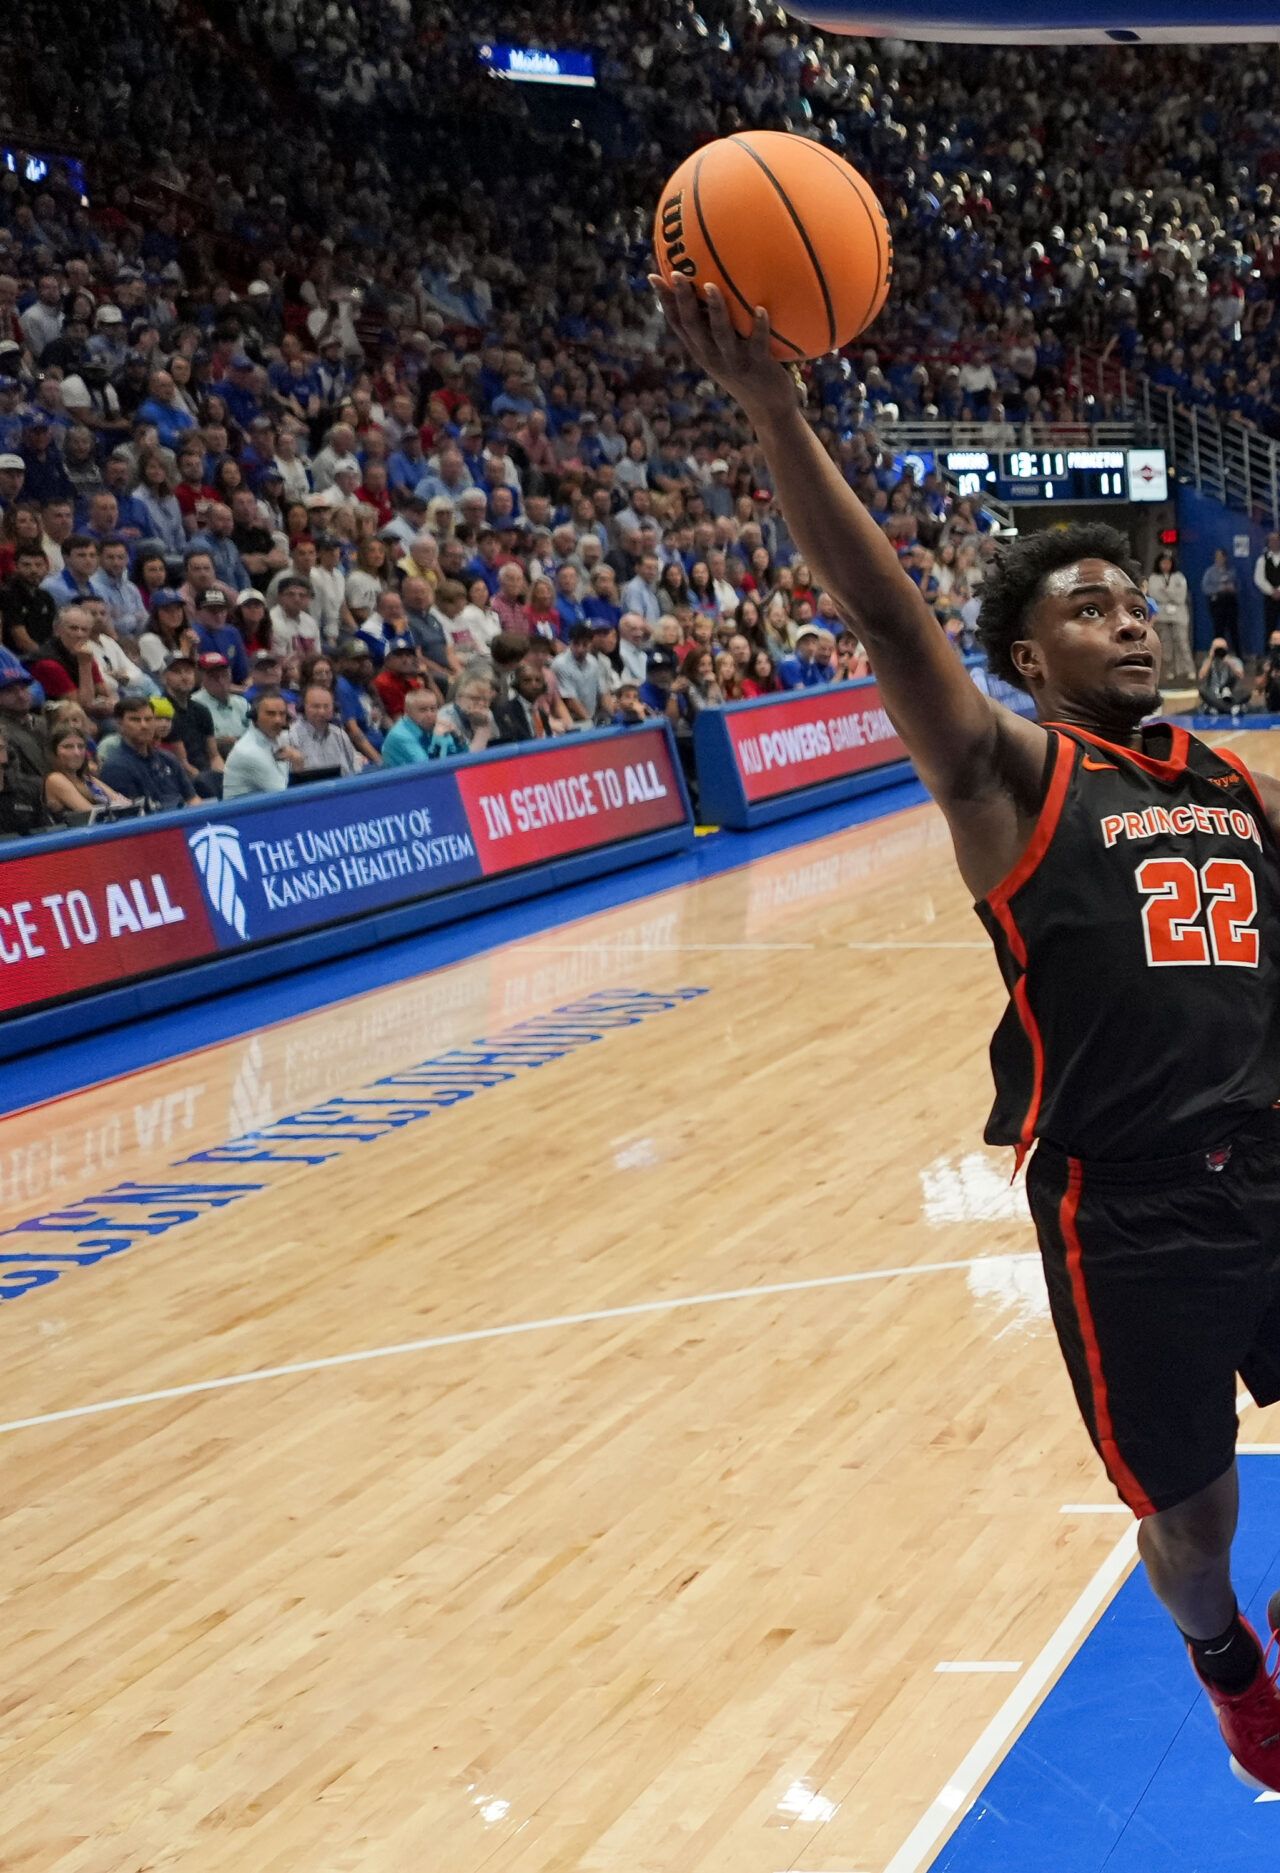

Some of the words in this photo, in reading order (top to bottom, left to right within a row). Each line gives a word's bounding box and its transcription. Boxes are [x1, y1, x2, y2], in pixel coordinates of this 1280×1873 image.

[1011, 451, 1063, 478] 13:11
[1045, 481, 1053, 498] 1
[1101, 472, 1121, 495] 11
[738, 735, 763, 777] KU
[759, 719, 831, 771] POWERS
[478, 792, 513, 841] IN
[510, 773, 599, 832] SERVICE
[593, 767, 624, 811] TO
[623, 760, 667, 805] ALL
[249, 839, 299, 876] THE
[296, 814, 407, 865] UNIVERSITY
[407, 807, 433, 839] OF
[261, 865, 342, 911] KANSAS
[340, 846, 413, 890] HEALTH
[411, 832, 475, 873] SYSTEM
[41, 889, 100, 950] TO
[105, 873, 187, 938] ALL
[1134, 857, 1260, 969] 22
